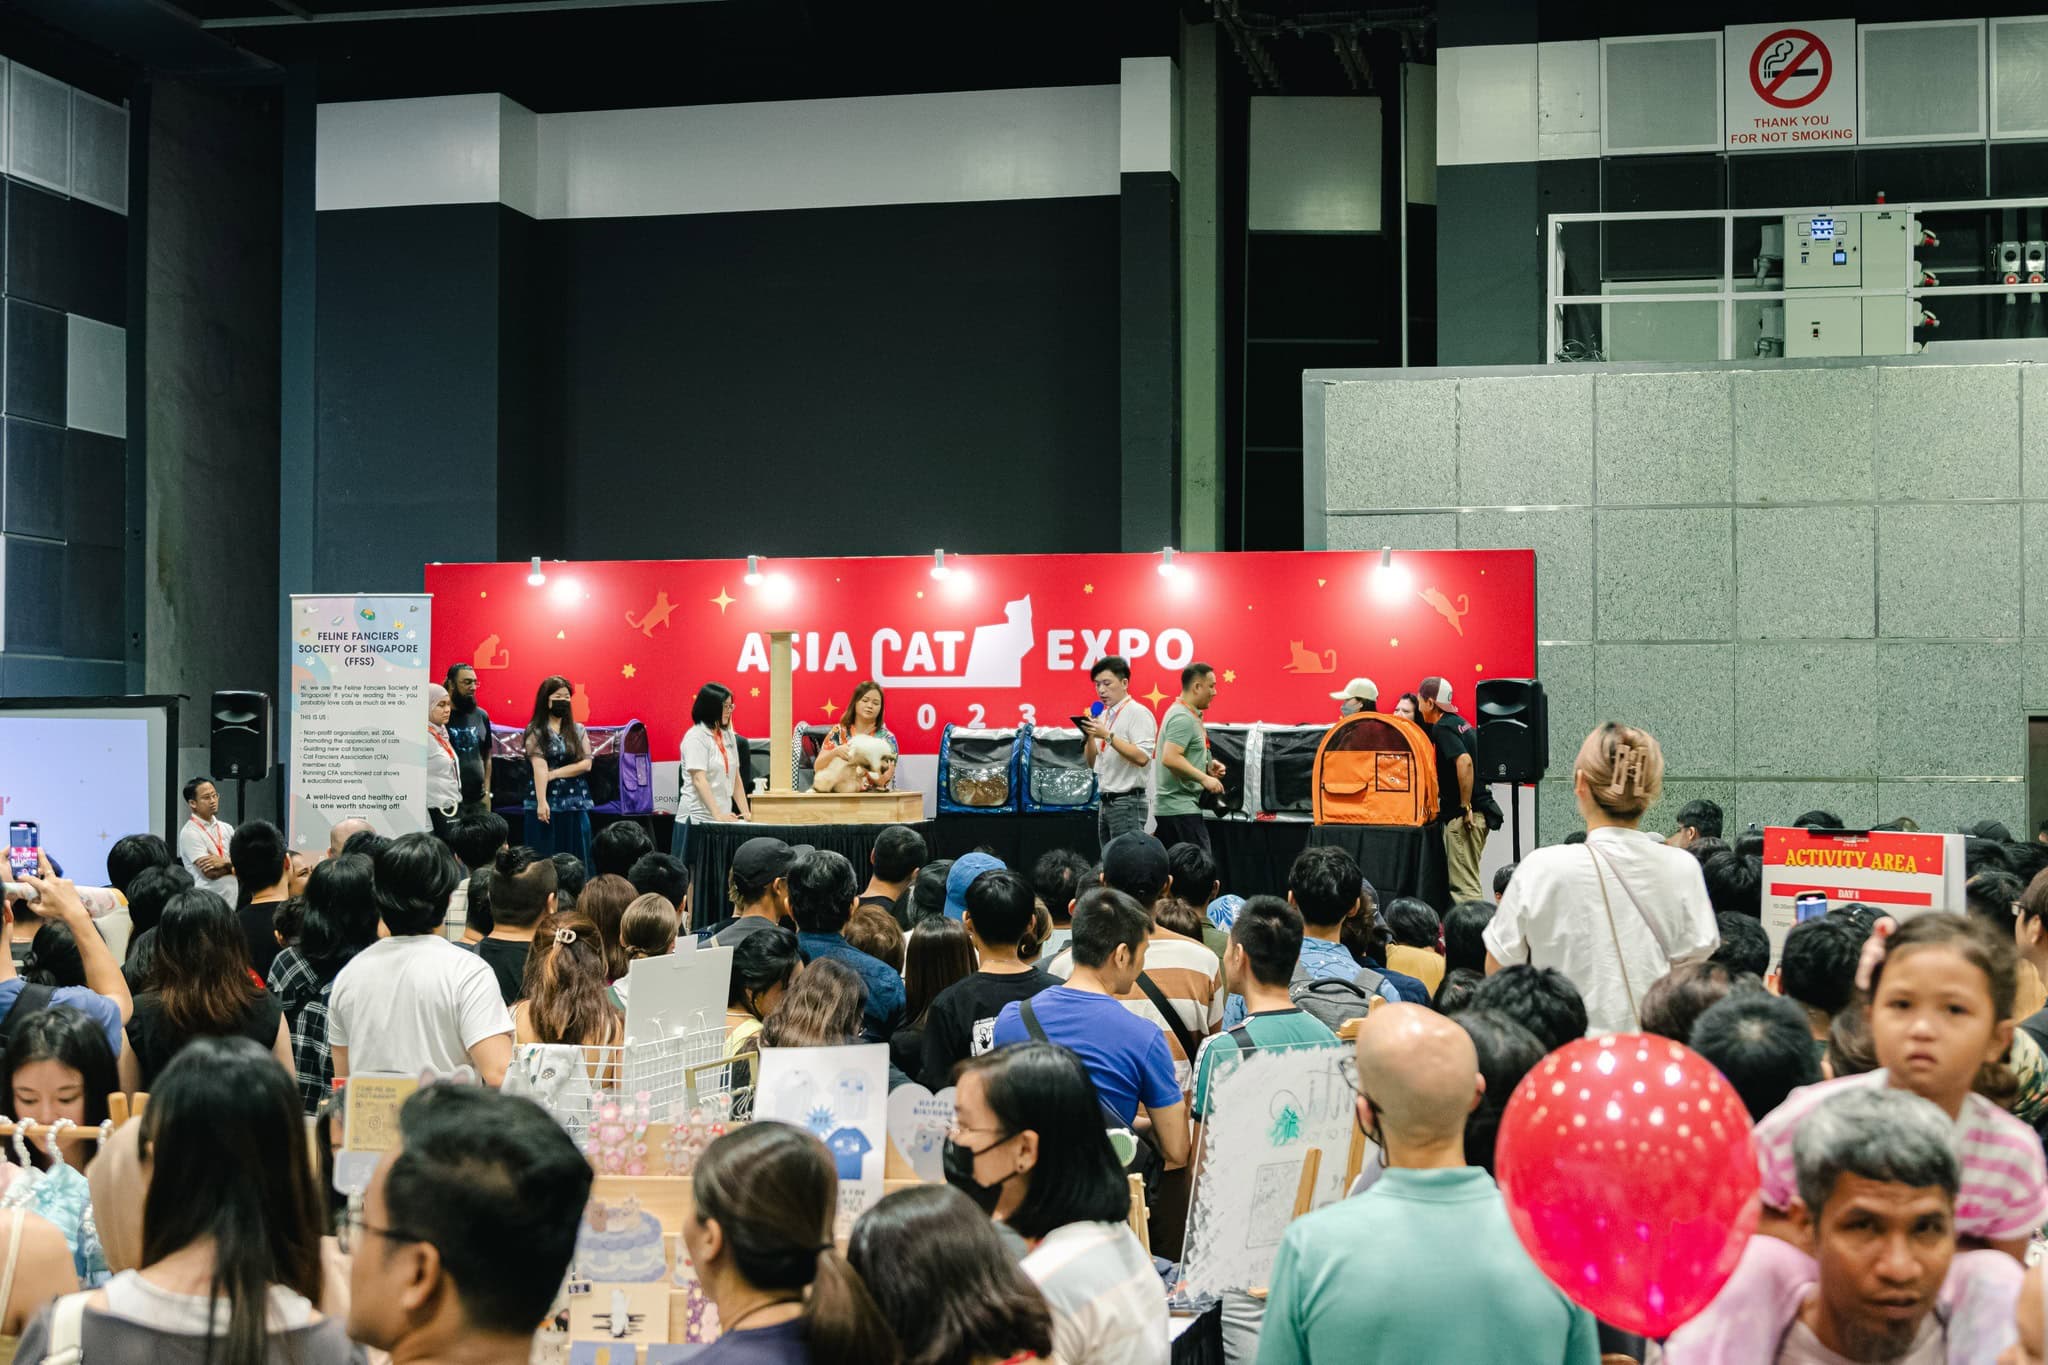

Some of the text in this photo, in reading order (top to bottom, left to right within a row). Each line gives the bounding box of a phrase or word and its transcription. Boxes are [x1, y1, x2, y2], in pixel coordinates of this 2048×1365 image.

[1754, 115, 1829, 128] THANK YOU
[1731, 128, 1853, 144] FOR NOT SMOKING
[317, 632, 399, 640] FELINE FANCIERS
[298, 644, 418, 653] SOCIETY OF SINGAPORE
[872, 627, 967, 687] CAT
[1047, 628, 1195, 671] EXPO
[344, 657, 375, 667] (FFSS)
[363, 692, 384, 700] reading
[300, 699, 326, 707] probably
[368, 793, 393, 802] healthy
[358, 802, 387, 811] showing
[1785, 848, 1918, 874] ACTIVITY AREA
[1838, 889, 1854, 899] DAY
